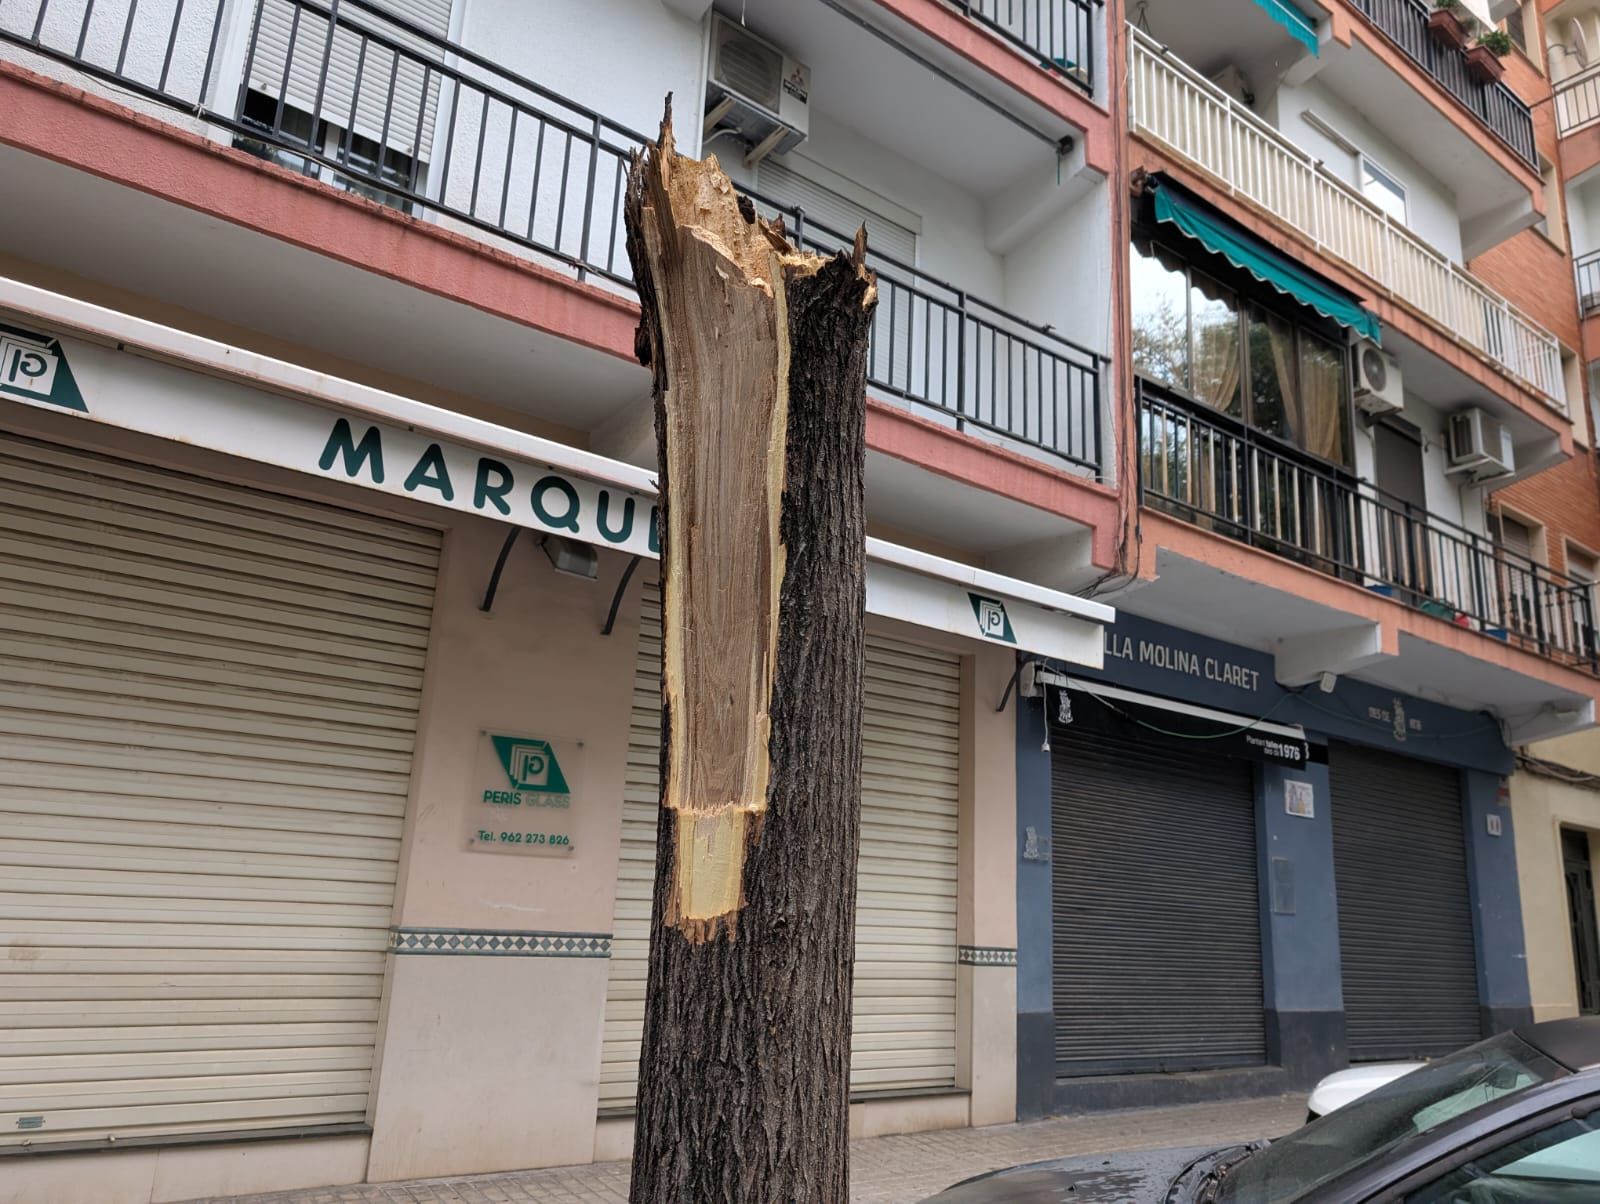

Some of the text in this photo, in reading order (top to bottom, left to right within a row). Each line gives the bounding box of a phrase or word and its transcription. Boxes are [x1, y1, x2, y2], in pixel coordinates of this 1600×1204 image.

[1139, 639, 1200, 677] MOLINA
[1204, 657, 1259, 692] CLARET
[483, 790, 522, 805] PERIS
[479, 830, 570, 846] Tel. 962 273 826
